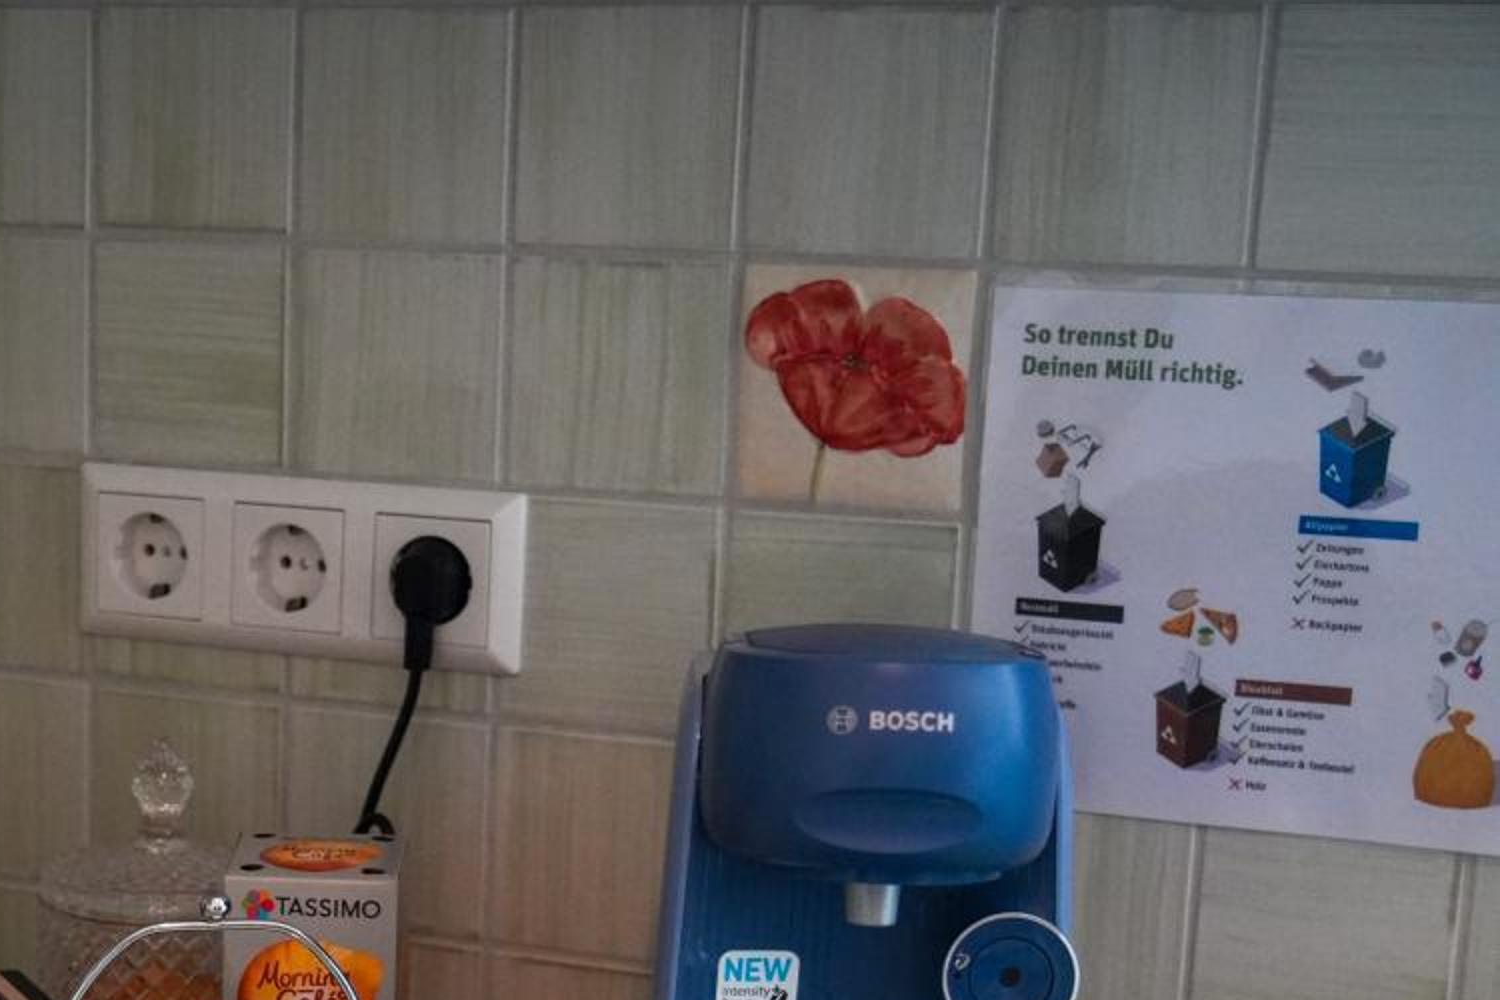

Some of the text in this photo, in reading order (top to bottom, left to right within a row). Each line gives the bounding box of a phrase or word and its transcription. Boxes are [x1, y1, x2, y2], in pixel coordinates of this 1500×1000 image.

[1023, 323, 1174, 349] So trennst Du
[1022, 355, 1244, 391] Deinen Müll richtig.
[868, 710, 956, 733] BOSCH
[275, 896, 381, 919] TASSIMO
[724, 957, 792, 982] NEW
[722, 986, 771, 999] Intensity
